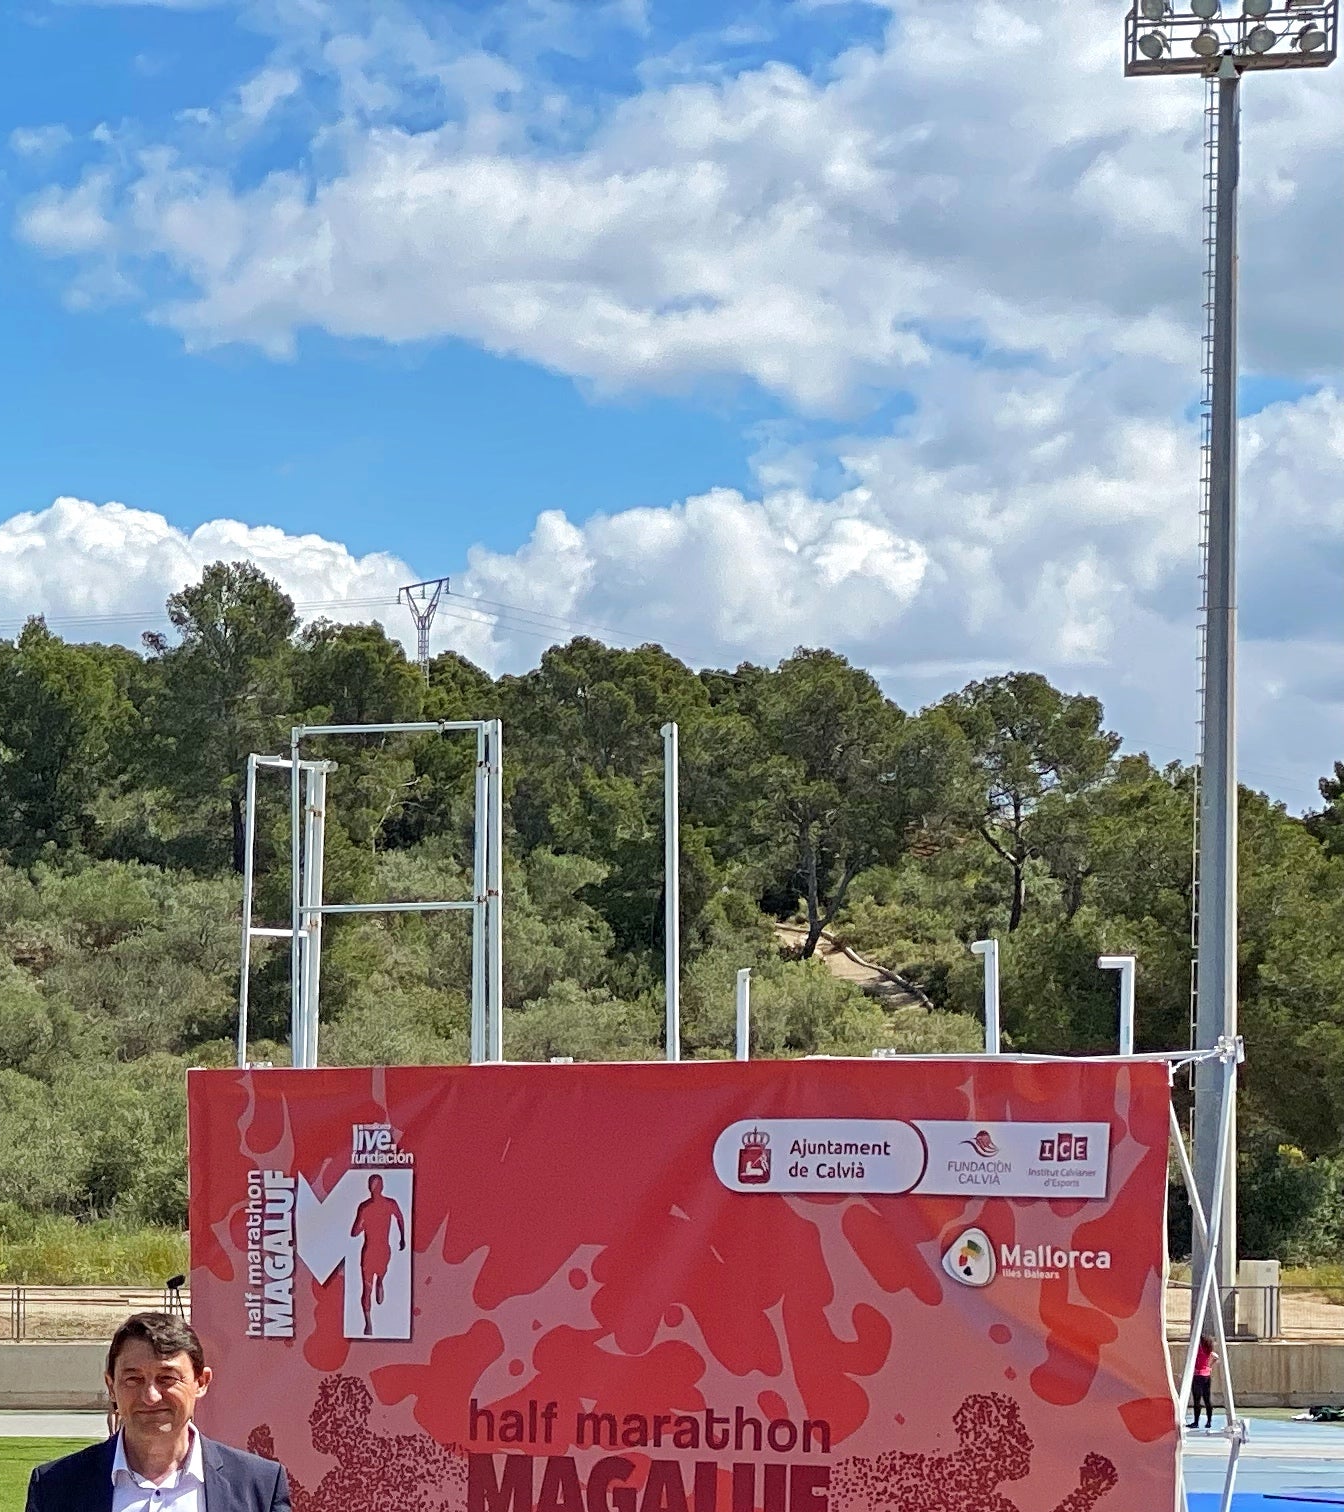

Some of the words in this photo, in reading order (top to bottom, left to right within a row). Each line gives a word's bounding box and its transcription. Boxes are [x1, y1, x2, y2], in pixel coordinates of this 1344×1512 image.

[351, 1149, 414, 1164] fundación
[789, 1139, 891, 1158] Ajuntament
[1041, 1140, 1086, 1159] ICE
[788, 1166, 809, 1178] de
[815, 1163, 865, 1179] Calvià
[1028, 1168, 1059, 1177] Institut
[245, 1170, 262, 1286] marathon
[263, 1170, 295, 1337] MAGALUF
[1001, 1244, 1111, 1269] Mallorca
[246, 1291, 262, 1337] half
[469, 1398, 558, 1443] half
[576, 1408, 832, 1454] marathon
